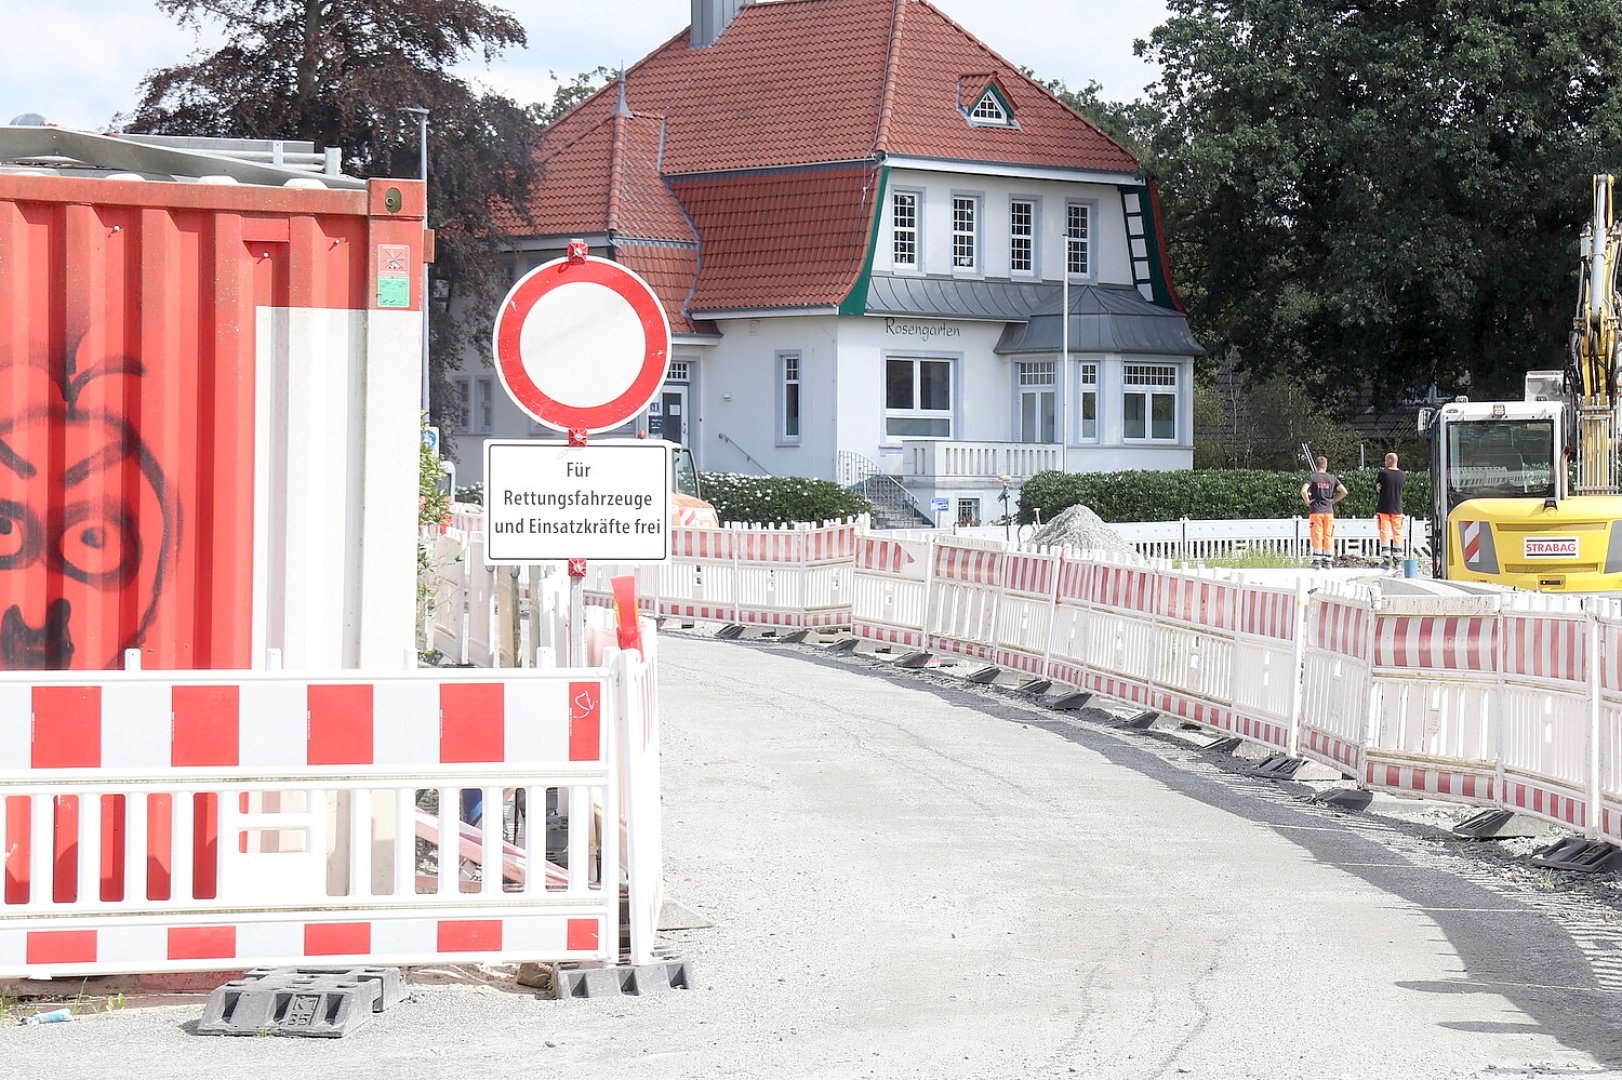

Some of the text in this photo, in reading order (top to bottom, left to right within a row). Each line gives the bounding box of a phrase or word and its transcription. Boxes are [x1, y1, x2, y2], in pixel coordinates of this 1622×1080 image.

[884, 317, 960, 342] Rosengarten
[566, 461, 591, 478] Für
[504, 489, 652, 510] Rettungsfahrzeuge
[494, 518, 661, 534] und Einsatzkräfte frei
[1526, 543, 1576, 552] STRABAG
